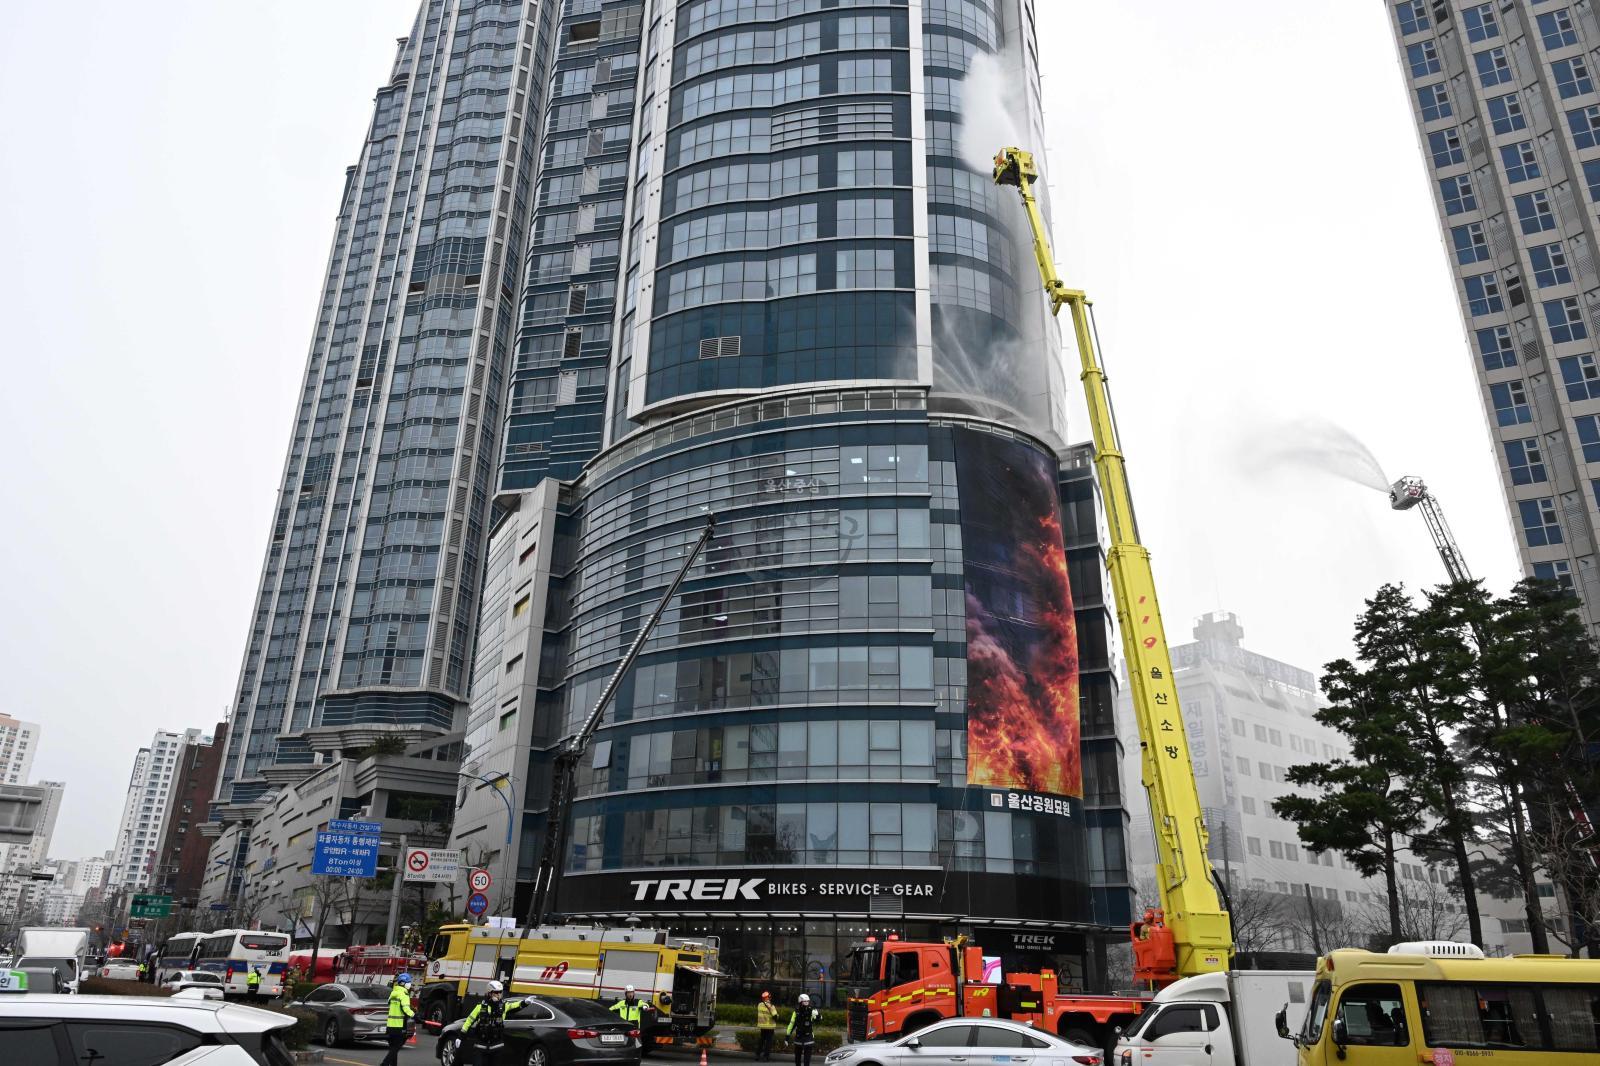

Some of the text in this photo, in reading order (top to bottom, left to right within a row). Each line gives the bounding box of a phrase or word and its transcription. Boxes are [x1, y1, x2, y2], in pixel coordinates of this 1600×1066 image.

[1151, 667, 1178, 760] 울산소방
[1185, 702, 1208, 778] 제일병원
[1008, 792, 1071, 818] 울산공원묘원
[319, 834, 377, 847] 화물자동차 통행제한
[474, 875, 487, 886] 50
[630, 878, 934, 901] TREK BIKES SERVICE GEAR
[1012, 934, 1055, 945] TREK
[541, 961, 569, 981] 119
